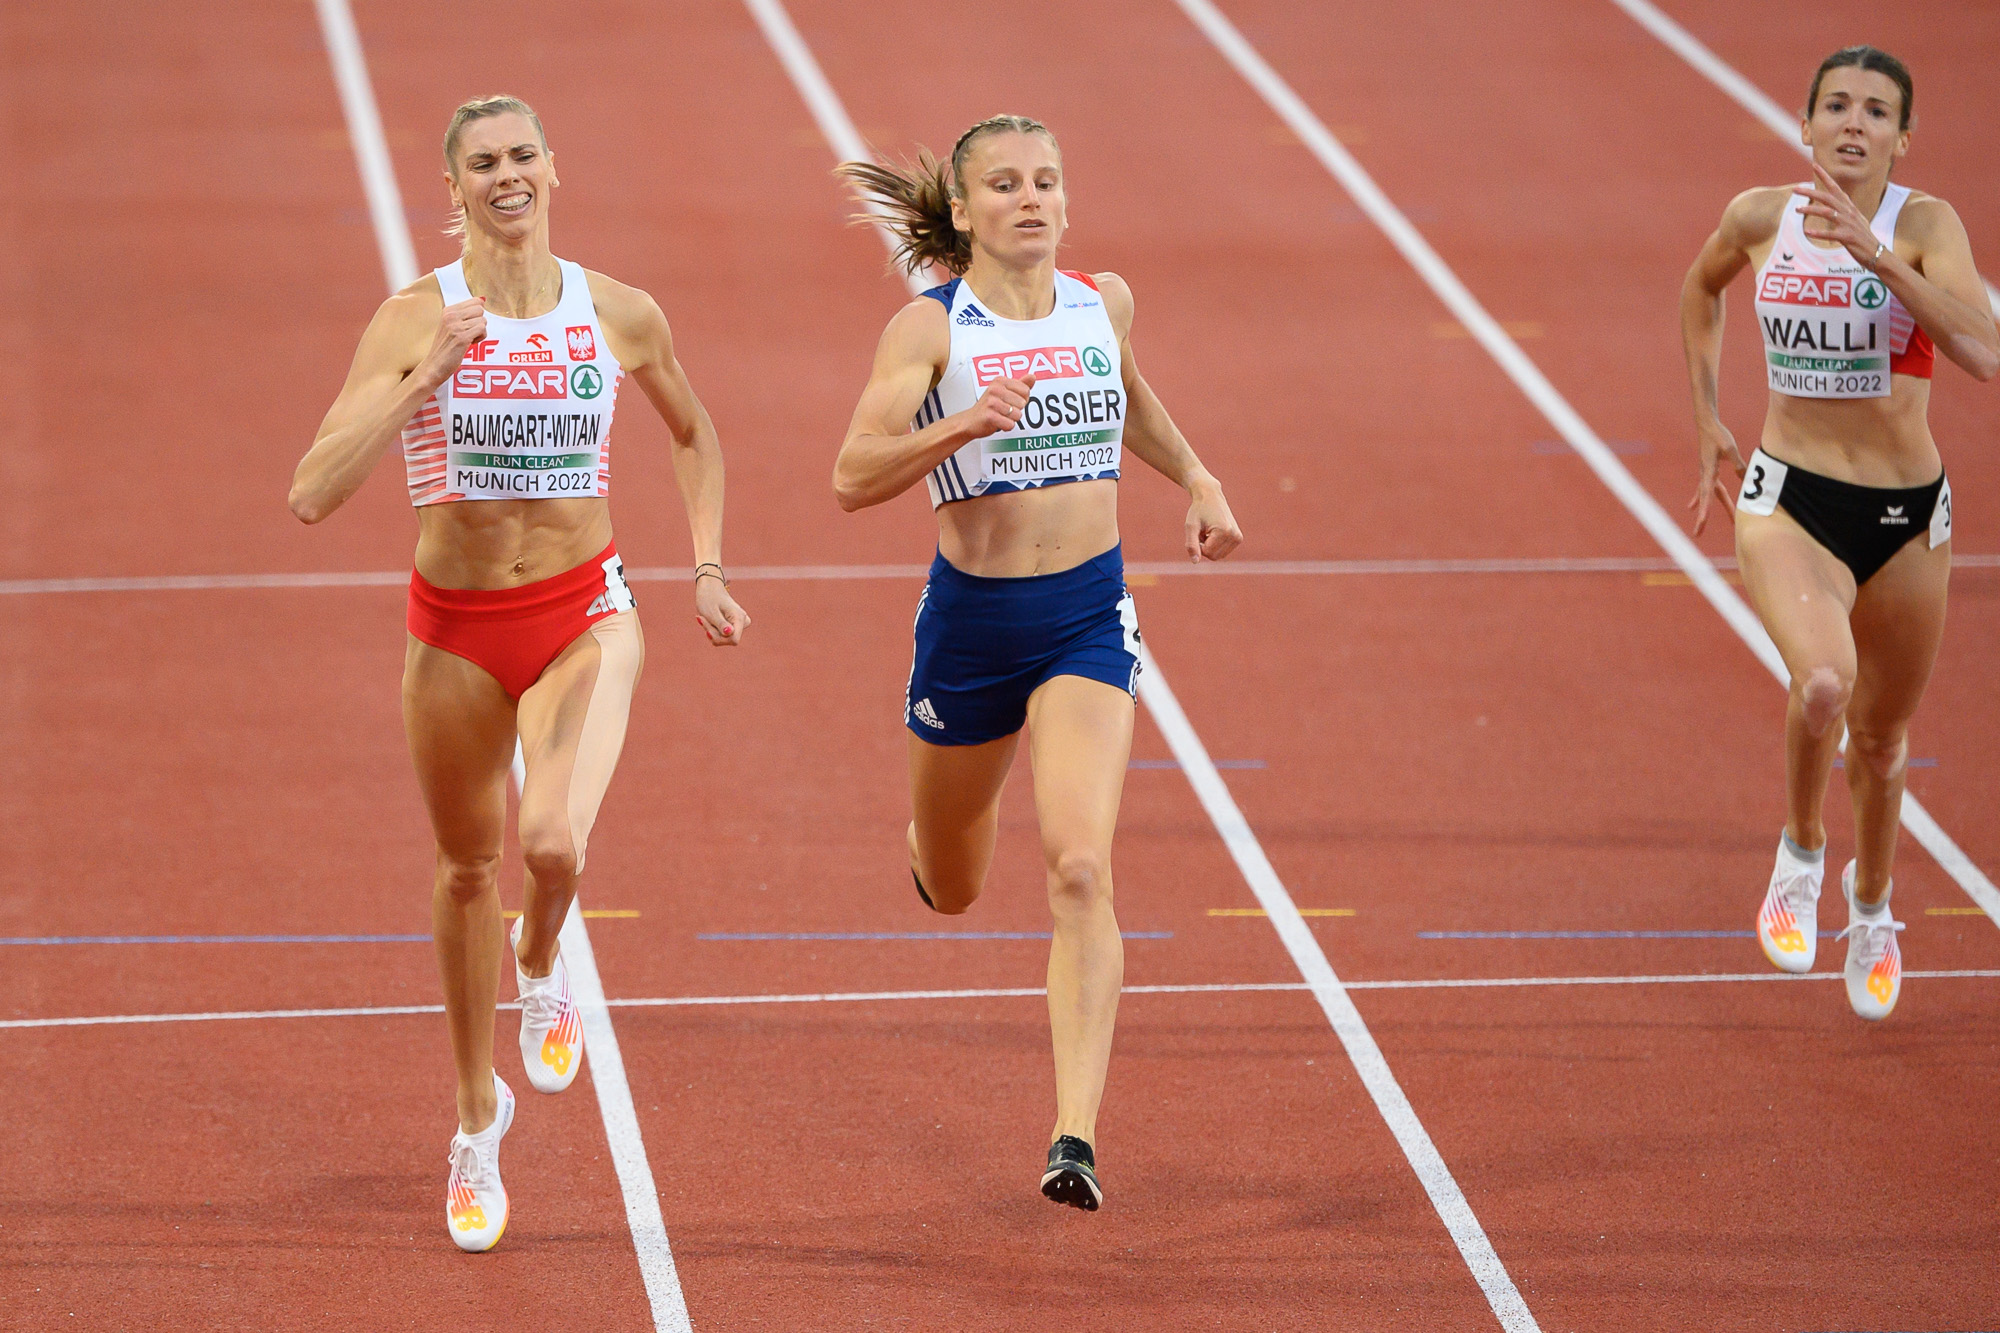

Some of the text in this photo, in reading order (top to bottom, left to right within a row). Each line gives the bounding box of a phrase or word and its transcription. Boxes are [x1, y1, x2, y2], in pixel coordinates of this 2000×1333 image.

[1762, 276, 1849, 305] SPAR
[956, 316, 996, 328] adidas
[1763, 315, 1876, 352] WALLI
[511, 351, 551, 363] ORLEN
[977, 350, 1080, 382] SPAR
[1783, 355, 1788, 366] I
[1788, 357, 1813, 369] RUN
[456, 369, 565, 395] SPAR
[1770, 368, 1882, 393] MUNICH 2022
[1012, 389, 1121, 431] OSSIER
[452, 413, 601, 448] BAUMGART-WITAN
[1017, 438, 1022, 450] I
[1025, 435, 1053, 449] RUN
[485, 455, 489, 466] I
[493, 456, 522, 468] RUN
[992, 446, 1114, 475] MUNICH 2022
[457, 470, 591, 492] MUNICH 2022
[1743, 464, 1766, 500] 3
